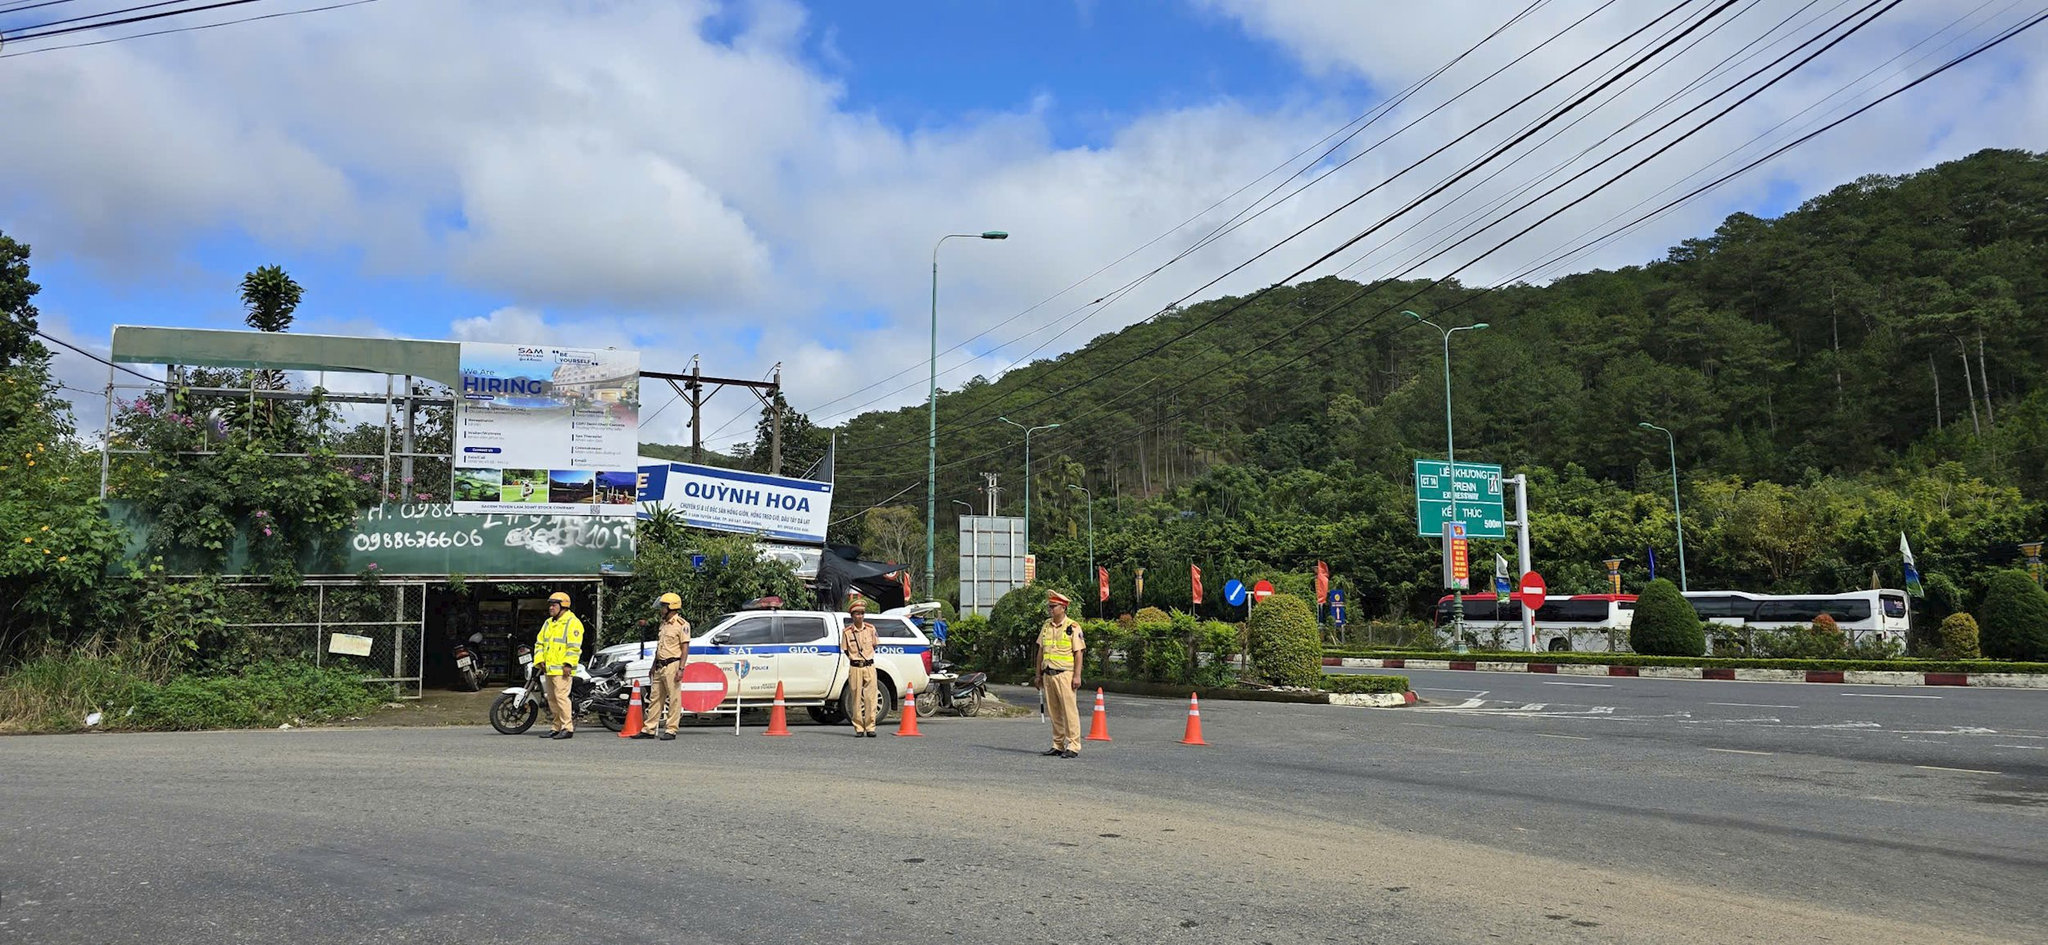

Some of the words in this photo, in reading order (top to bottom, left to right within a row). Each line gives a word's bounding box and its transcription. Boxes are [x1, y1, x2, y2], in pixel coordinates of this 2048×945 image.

[464, 376, 542, 394] HIRING
[1440, 465, 1452, 477] LIÊ
[684, 481, 760, 506] QUỲNH
[766, 492, 810, 512] HOA
[1442, 491, 1479, 500] EXRESSWAY
[1462, 506, 1483, 518] THÚC
[1484, 519, 1502, 529] 500m
[353, 529, 483, 551] 0988636606
[728, 645, 754, 655] SÁT
[788, 645, 819, 654] GIAO
[875, 645, 905, 654] HÔNG
